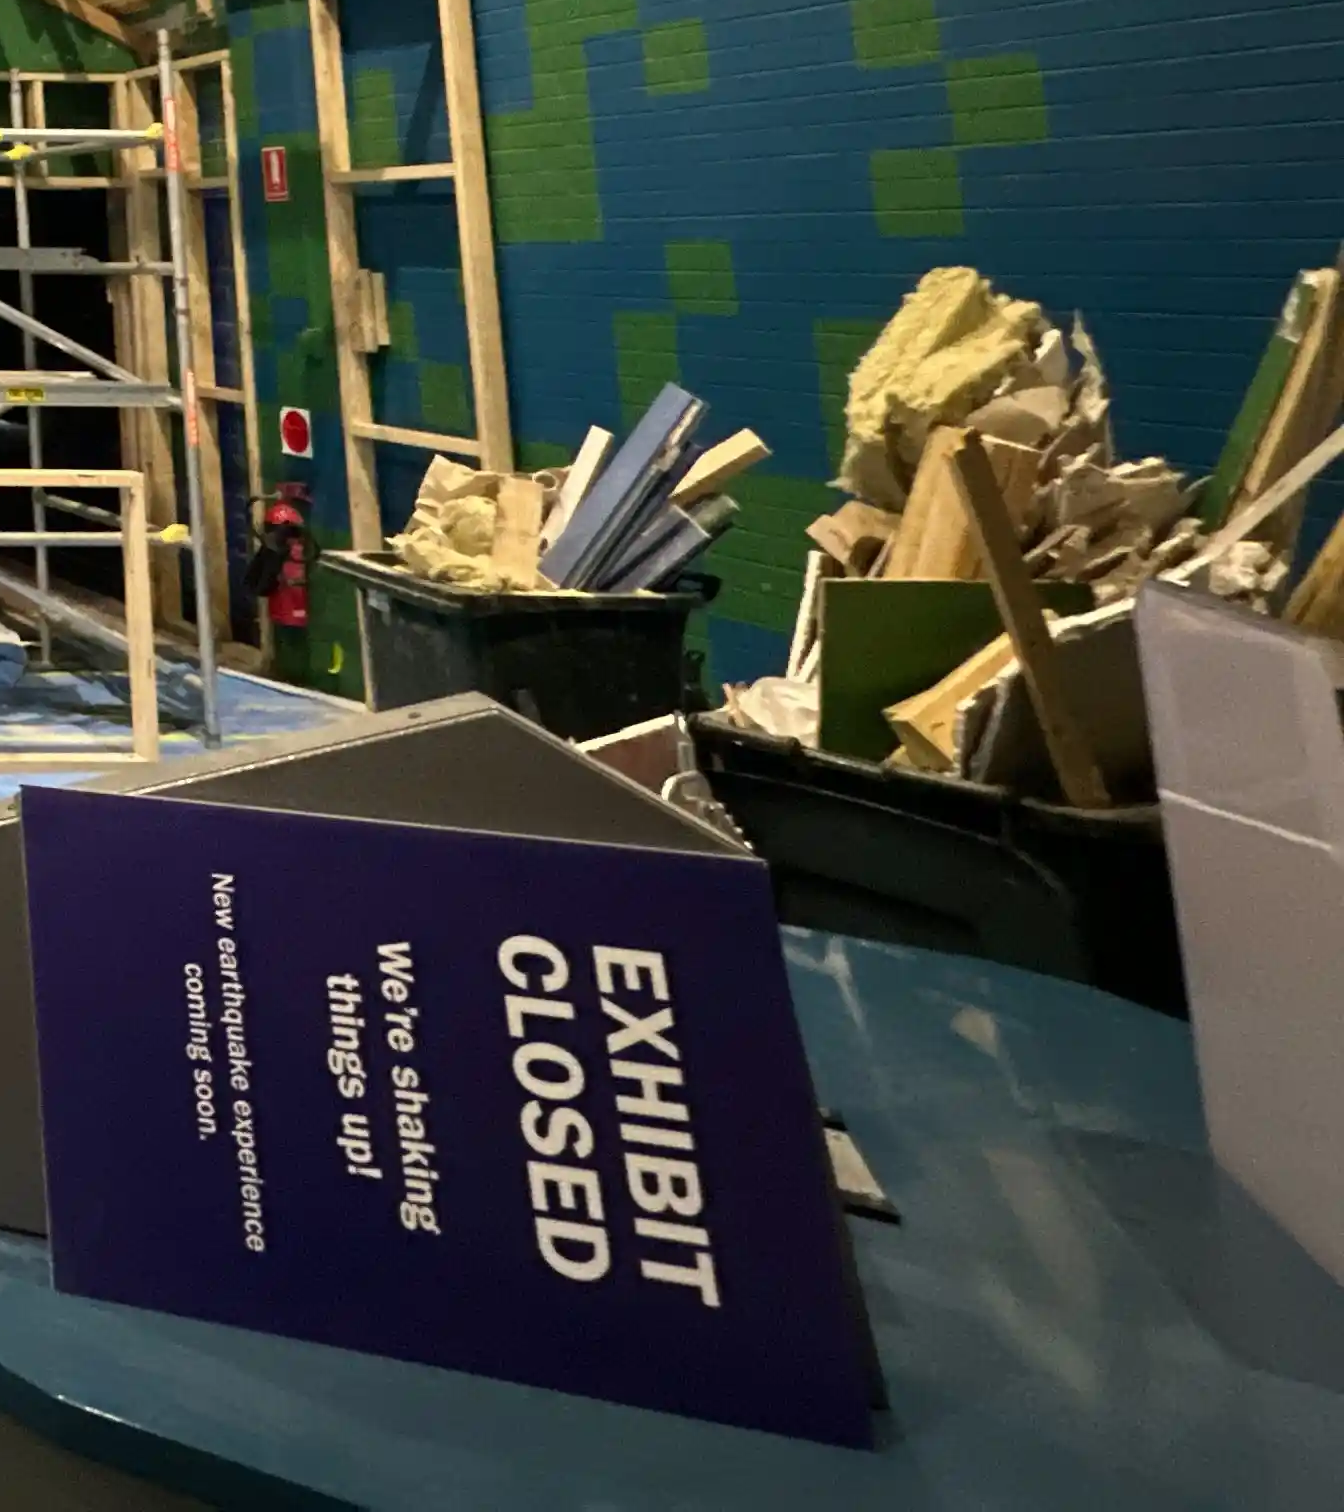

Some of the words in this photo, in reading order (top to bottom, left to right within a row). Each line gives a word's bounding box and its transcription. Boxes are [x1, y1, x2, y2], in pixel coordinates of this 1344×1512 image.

[212, 873, 235, 930] New
[184, 963, 212, 1062] coming
[218, 937, 252, 1091] earthquake
[326, 973, 367, 1098] things
[377, 942, 418, 1052] We're
[194, 1069, 216, 1140] soon.
[337, 1114, 383, 1178] up!
[391, 1065, 441, 1235] shaking
[498, 935, 610, 1281] CLOSED
[592, 945, 720, 1307] EXHIBIT
[231, 1100, 264, 1251] experience
